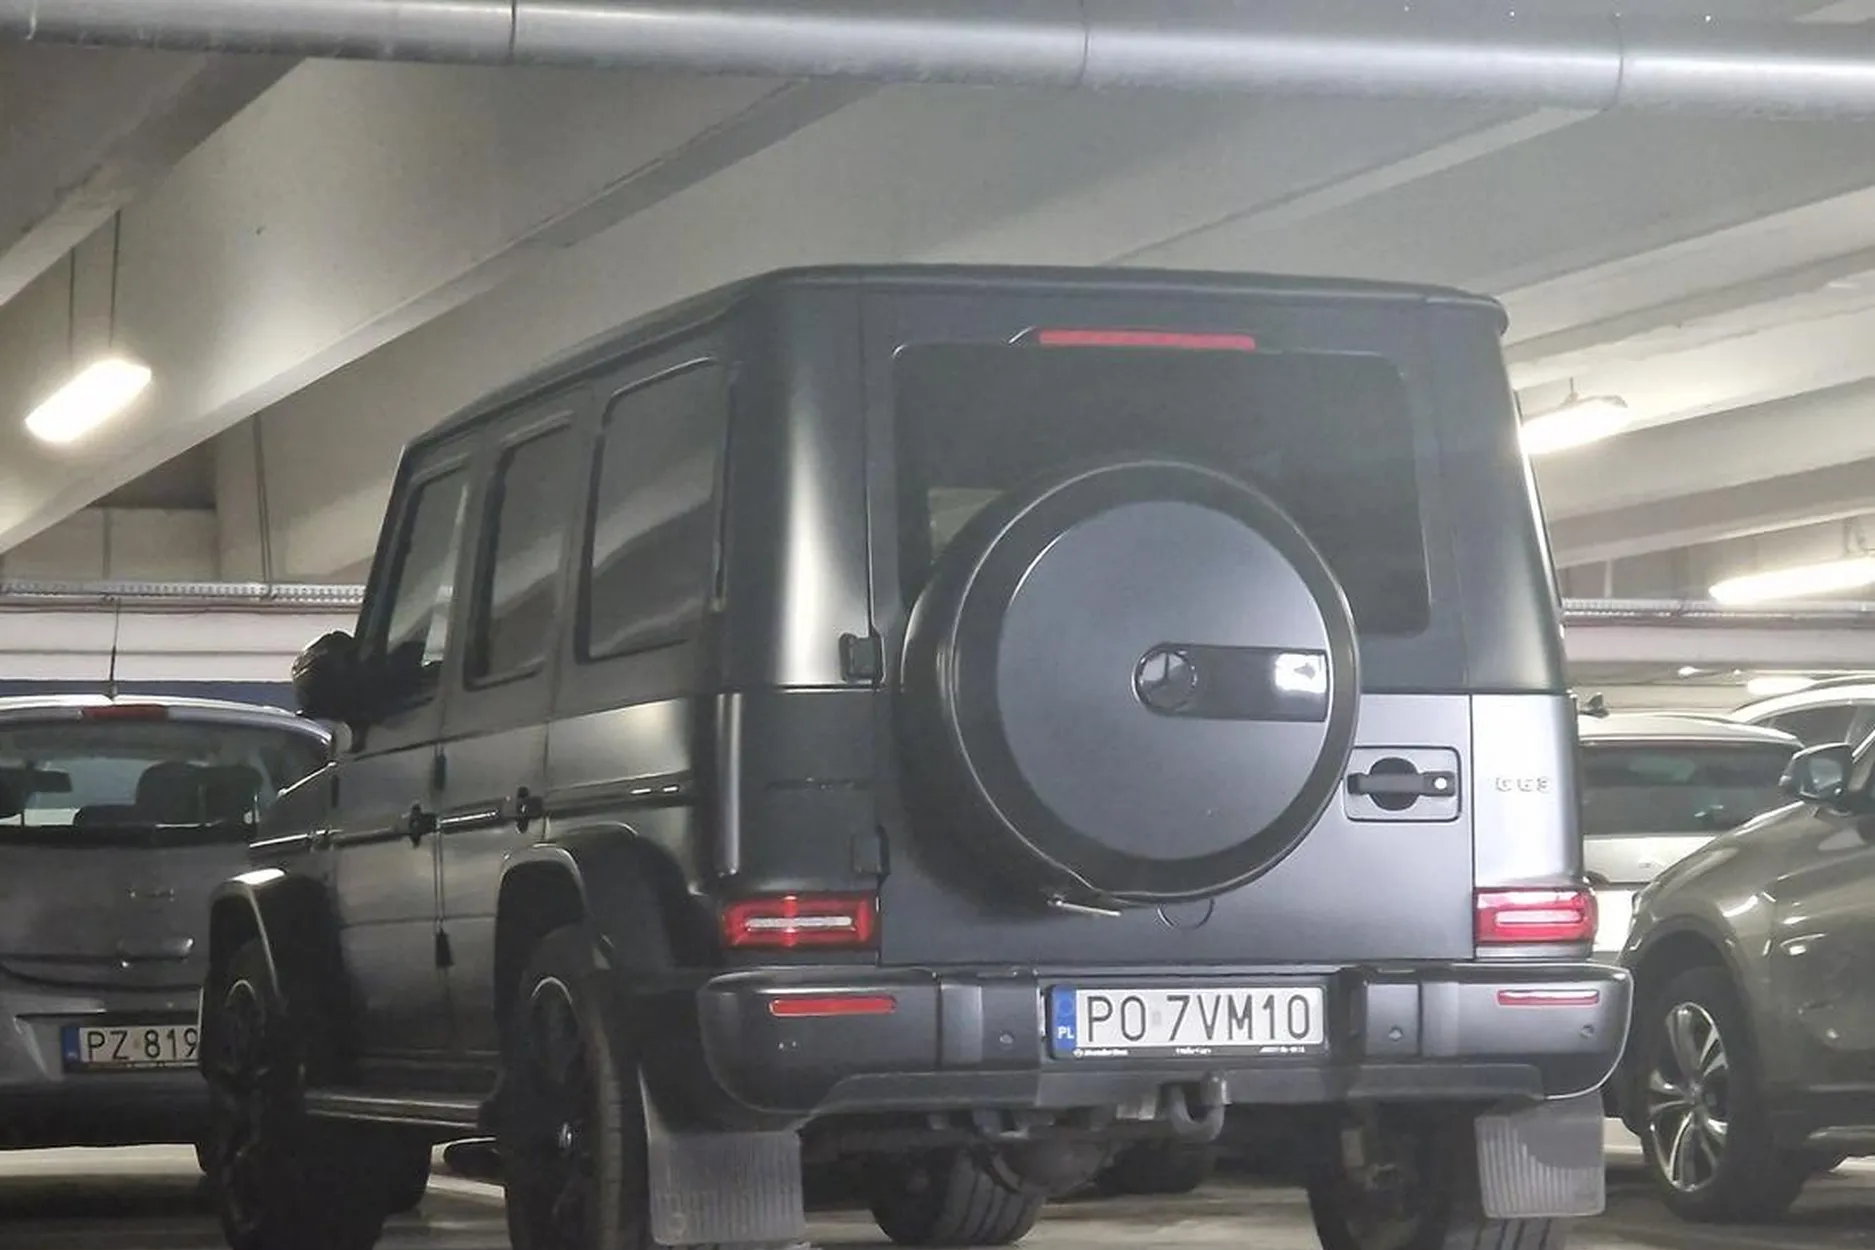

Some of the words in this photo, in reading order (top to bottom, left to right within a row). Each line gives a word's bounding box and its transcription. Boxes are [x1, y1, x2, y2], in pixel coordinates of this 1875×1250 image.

[1057, 1025, 1075, 1039] PL
[1086, 994, 1146, 1042] PO
[1166, 993, 1311, 1041] 7VM10
[87, 1030, 130, 1062] PZ
